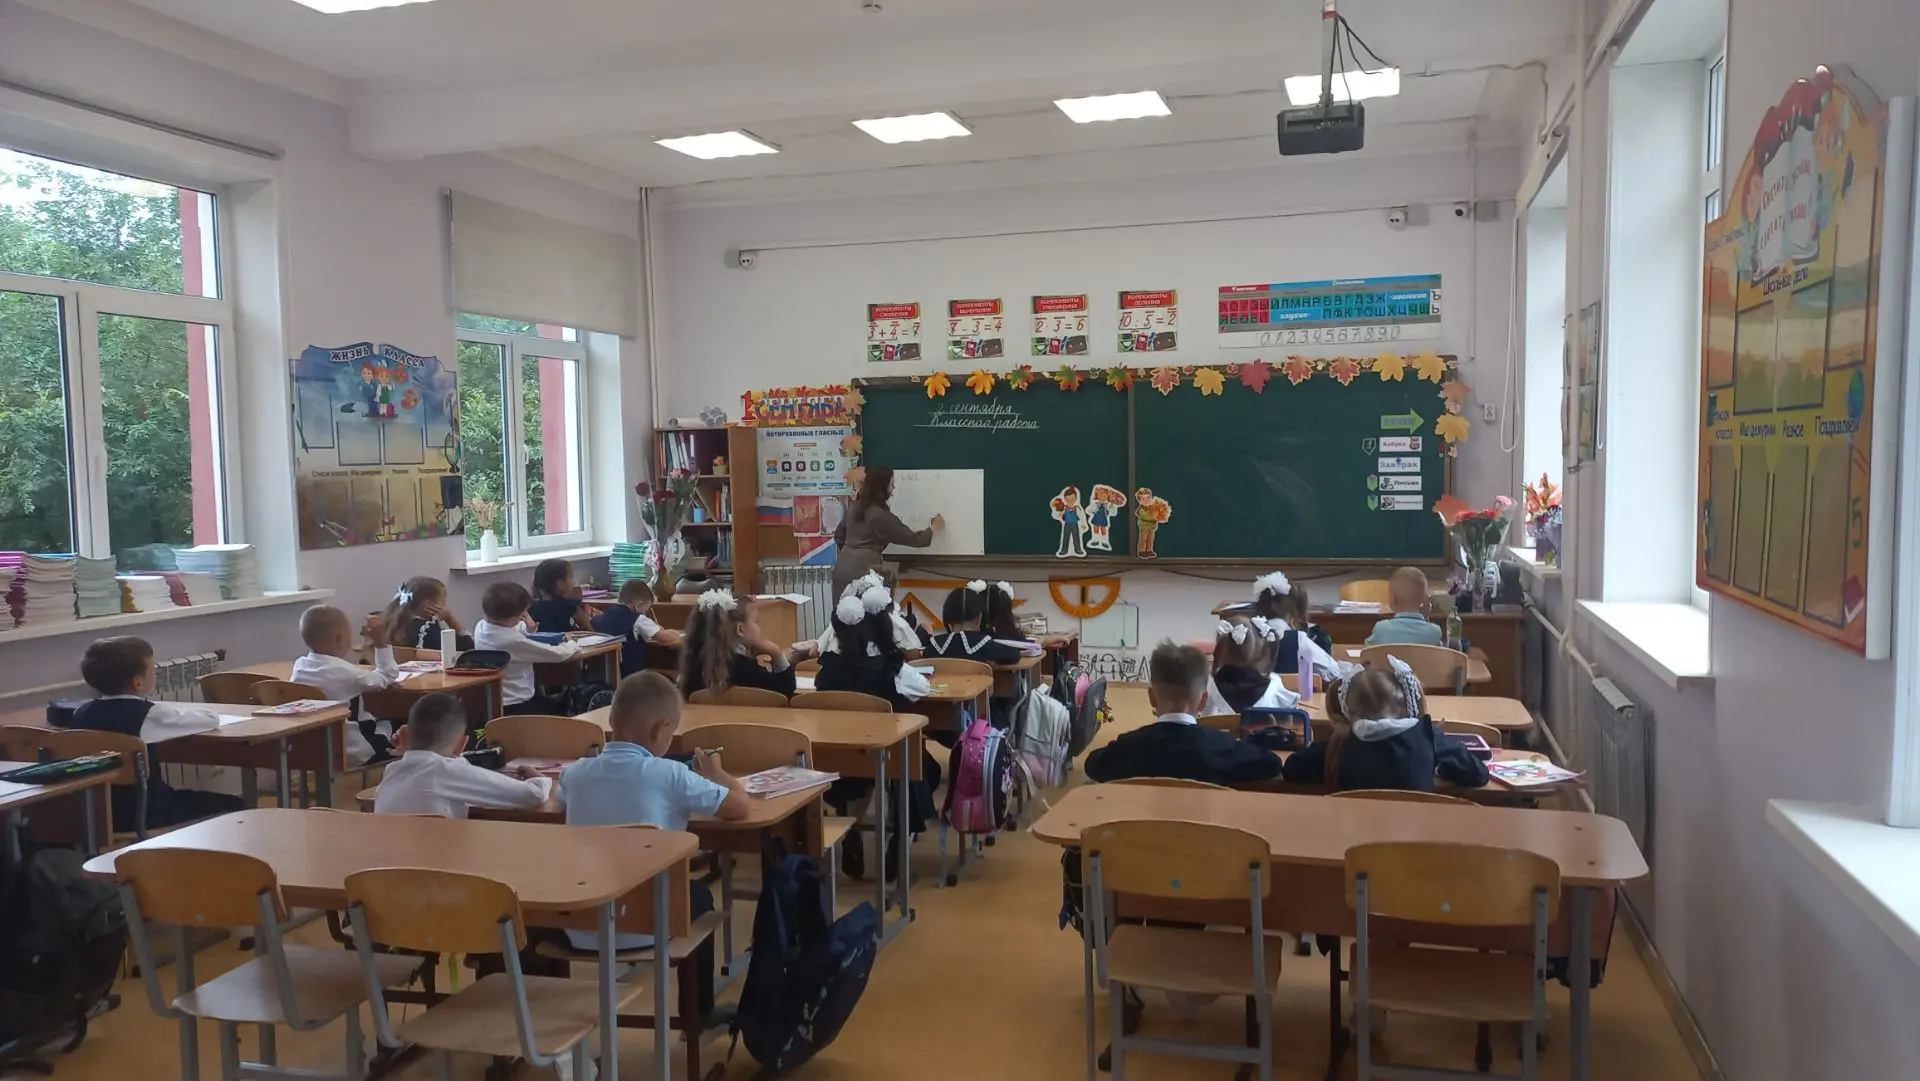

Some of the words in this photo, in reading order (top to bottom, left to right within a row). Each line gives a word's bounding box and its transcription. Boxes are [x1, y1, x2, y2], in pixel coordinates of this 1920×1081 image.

[972, 321, 980, 333] 3
[994, 321, 1002, 332] 4
[1035, 320, 1044, 333] 2
[1053, 319, 1061, 332] 3
[1077, 318, 1085, 331] 6
[1119, 314, 1132, 328] 10
[1143, 314, 1153, 327] 5
[1167, 312, 1176, 326] 2
[868, 326, 875, 339] 3
[878, 329, 886, 338] +
[890, 325, 897, 338] 4
[912, 325, 920, 337] 7
[331, 345, 370, 361] ЖИЗНЬ
[384, 347, 425, 368] КЛАССА
[741, 390, 756, 420] 1
[949, 397, 1013, 419] сентября
[930, 412, 991, 427] Классная
[815, 428, 844, 437] ГЛАСНЫЕ
[1783, 420, 1804, 437] Разное
